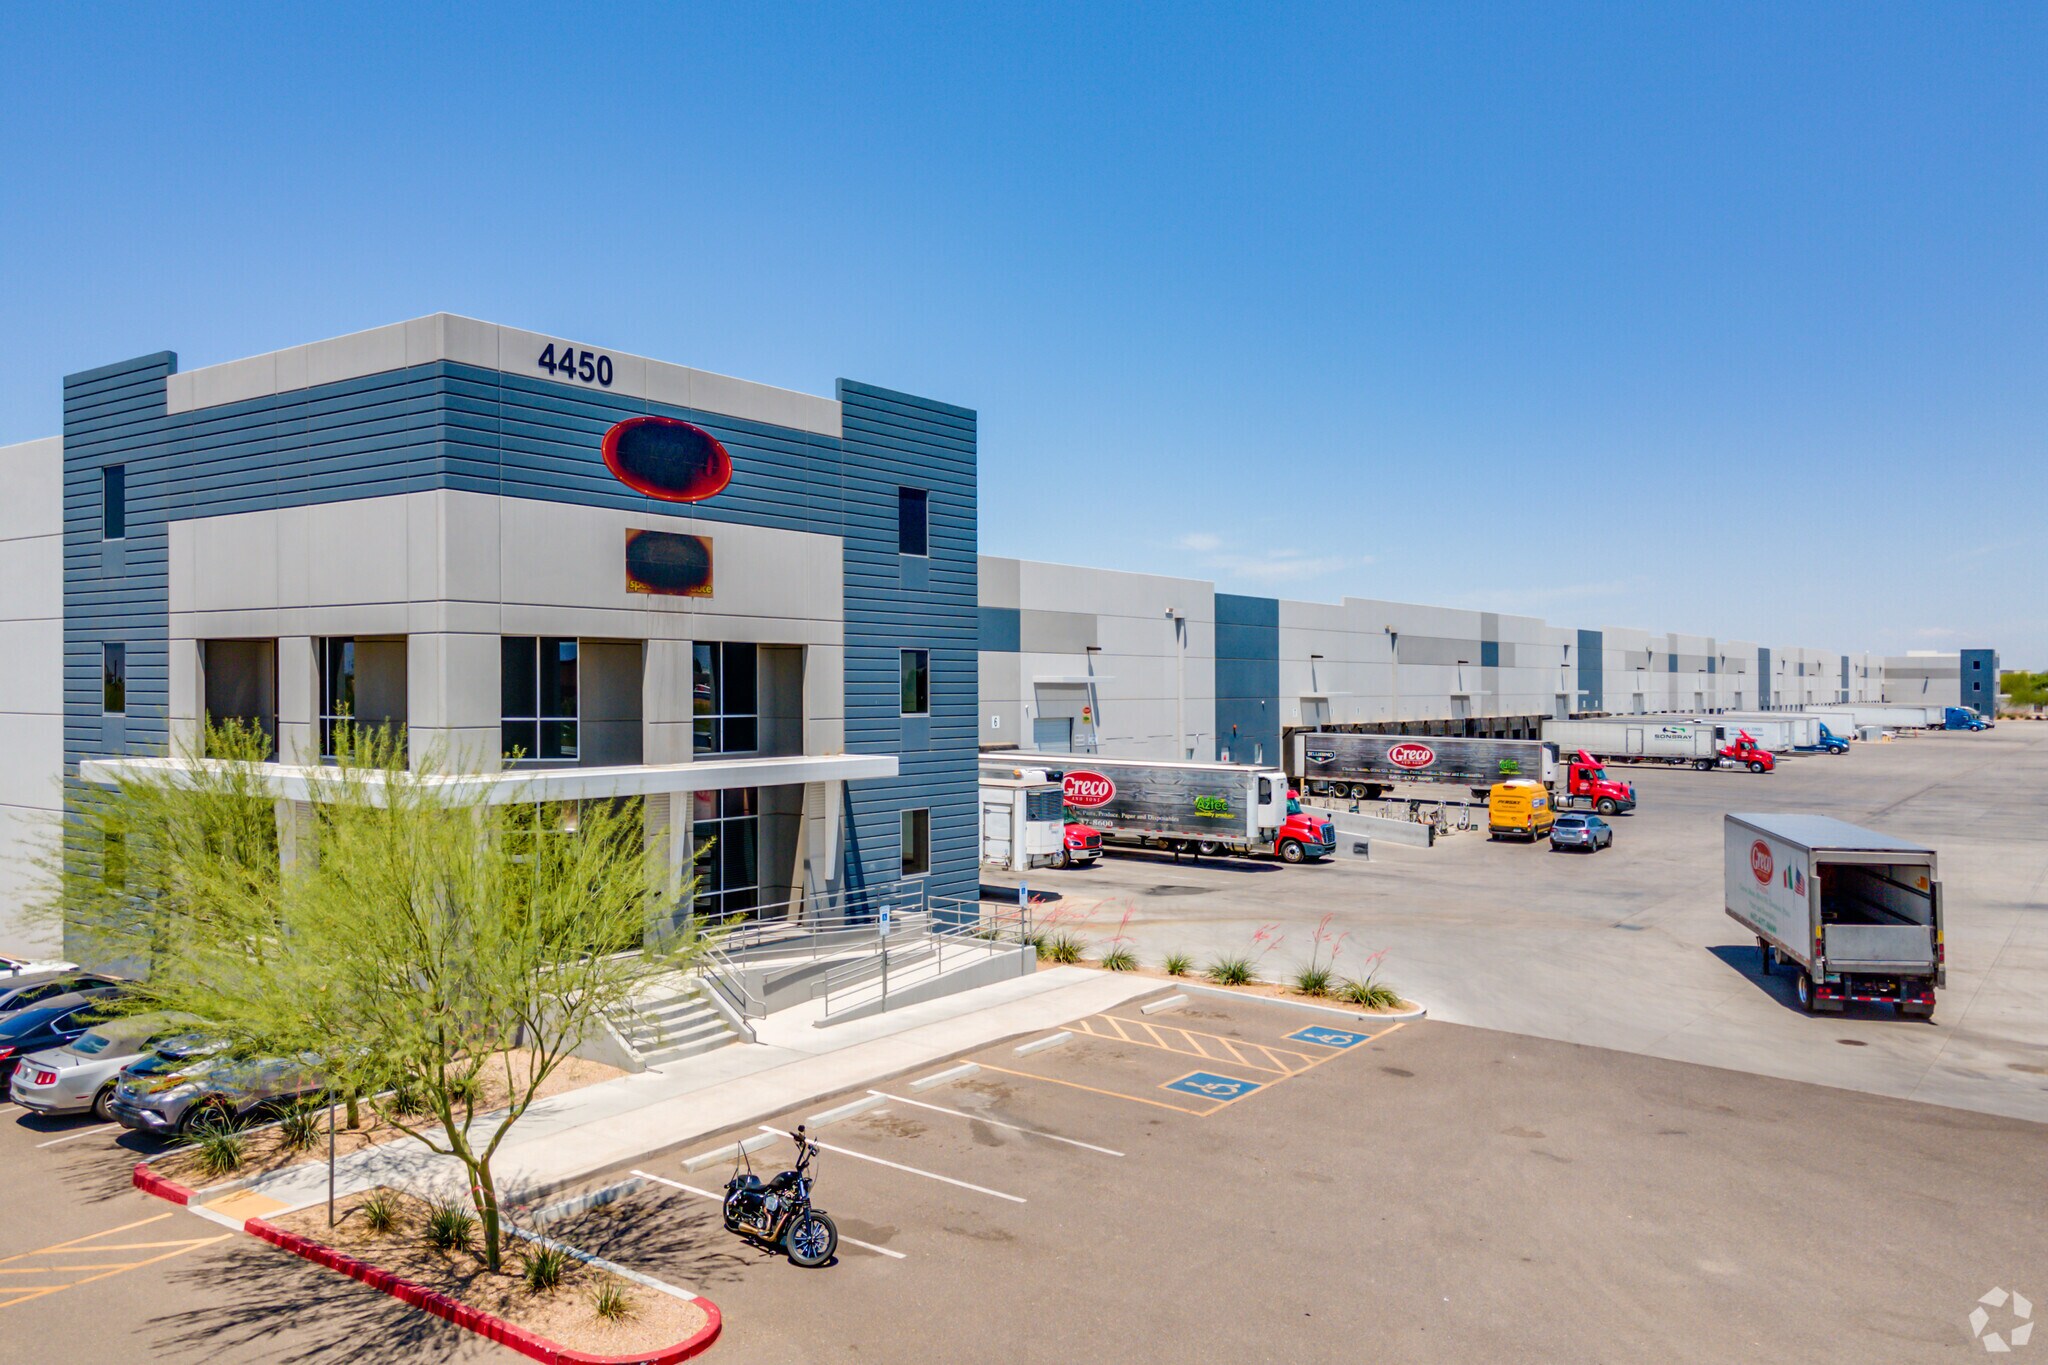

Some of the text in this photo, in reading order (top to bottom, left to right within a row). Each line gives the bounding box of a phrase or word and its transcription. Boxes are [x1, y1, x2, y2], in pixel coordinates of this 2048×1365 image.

[538, 342, 613, 387] 4450
[1391, 747, 1431, 762] Greco
[1062, 777, 1109, 796] Greco
[1196, 797, 1229, 811] Aztec
